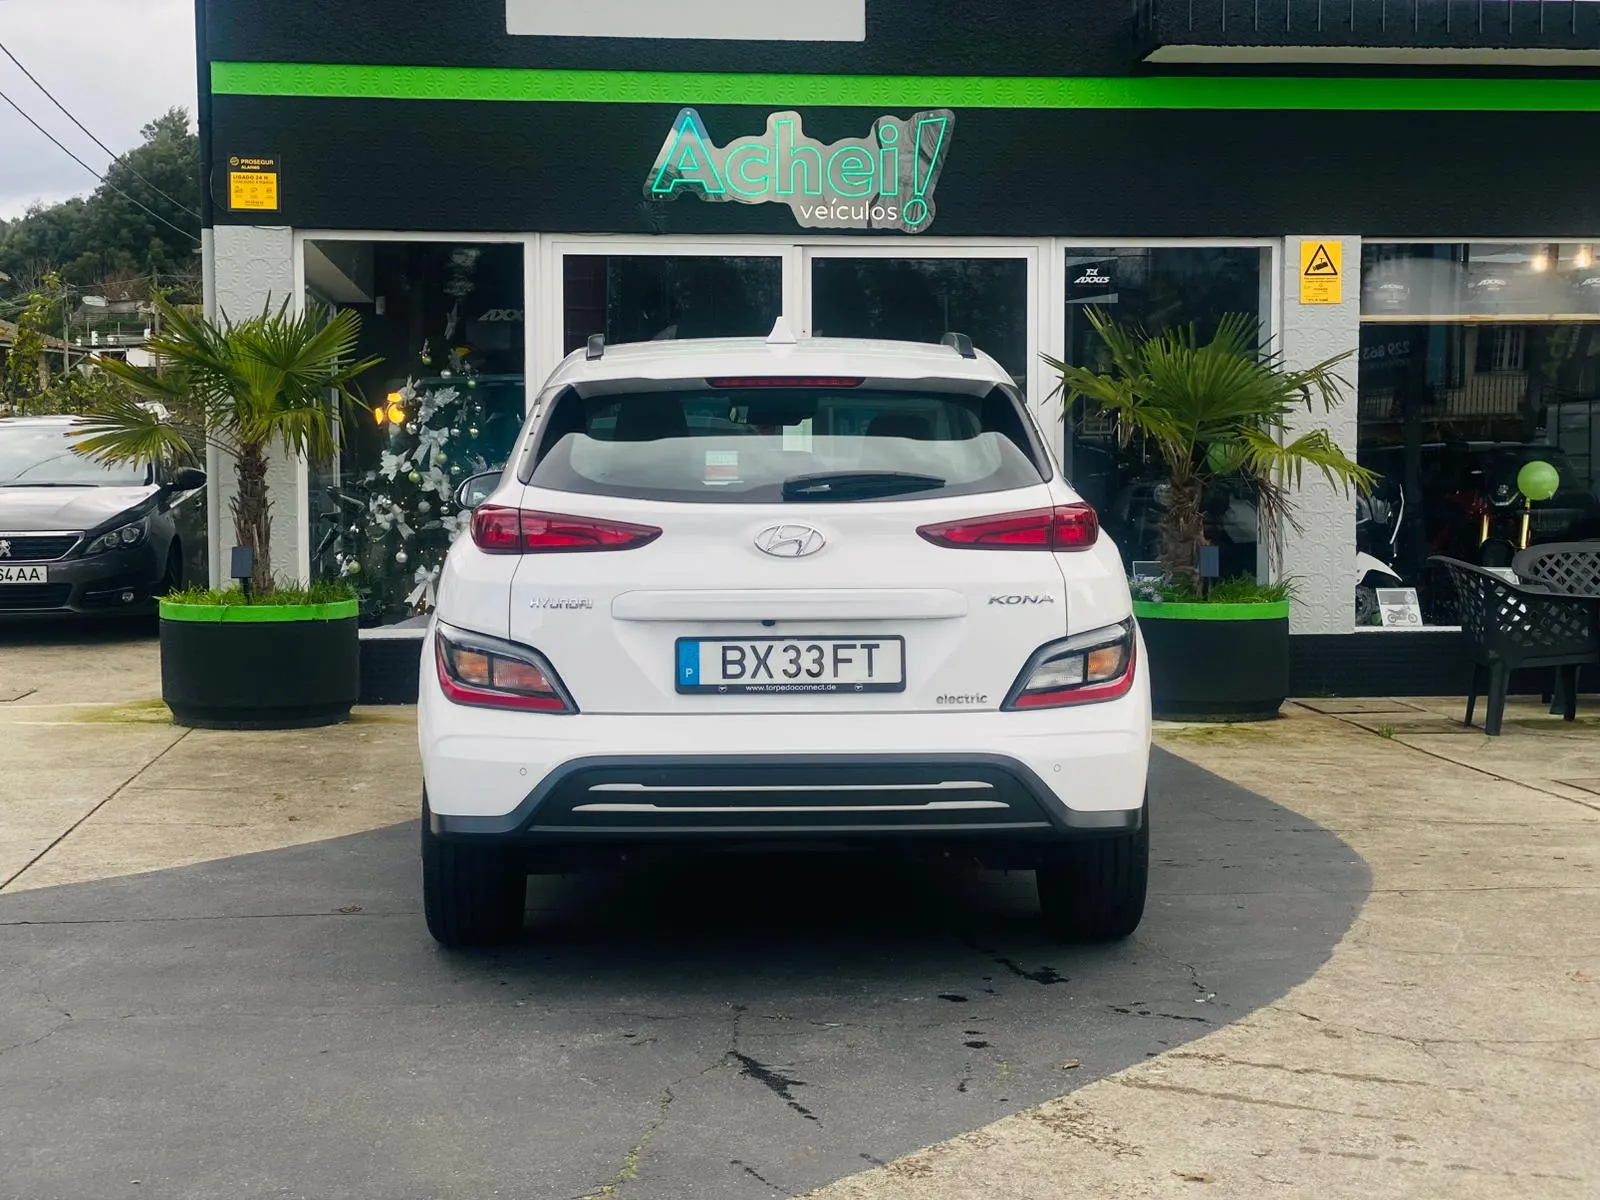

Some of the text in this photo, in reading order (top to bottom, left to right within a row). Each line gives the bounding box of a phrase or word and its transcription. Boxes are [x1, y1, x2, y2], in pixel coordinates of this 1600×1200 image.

[650, 115, 948, 225] Achei!
[800, 198, 897, 221] veículos
[987, 595, 1055, 605] KONA
[685, 668, 693, 678] P
[745, 683, 837, 692] www.torpedoconnect.de
[935, 692, 988, 705] electric
